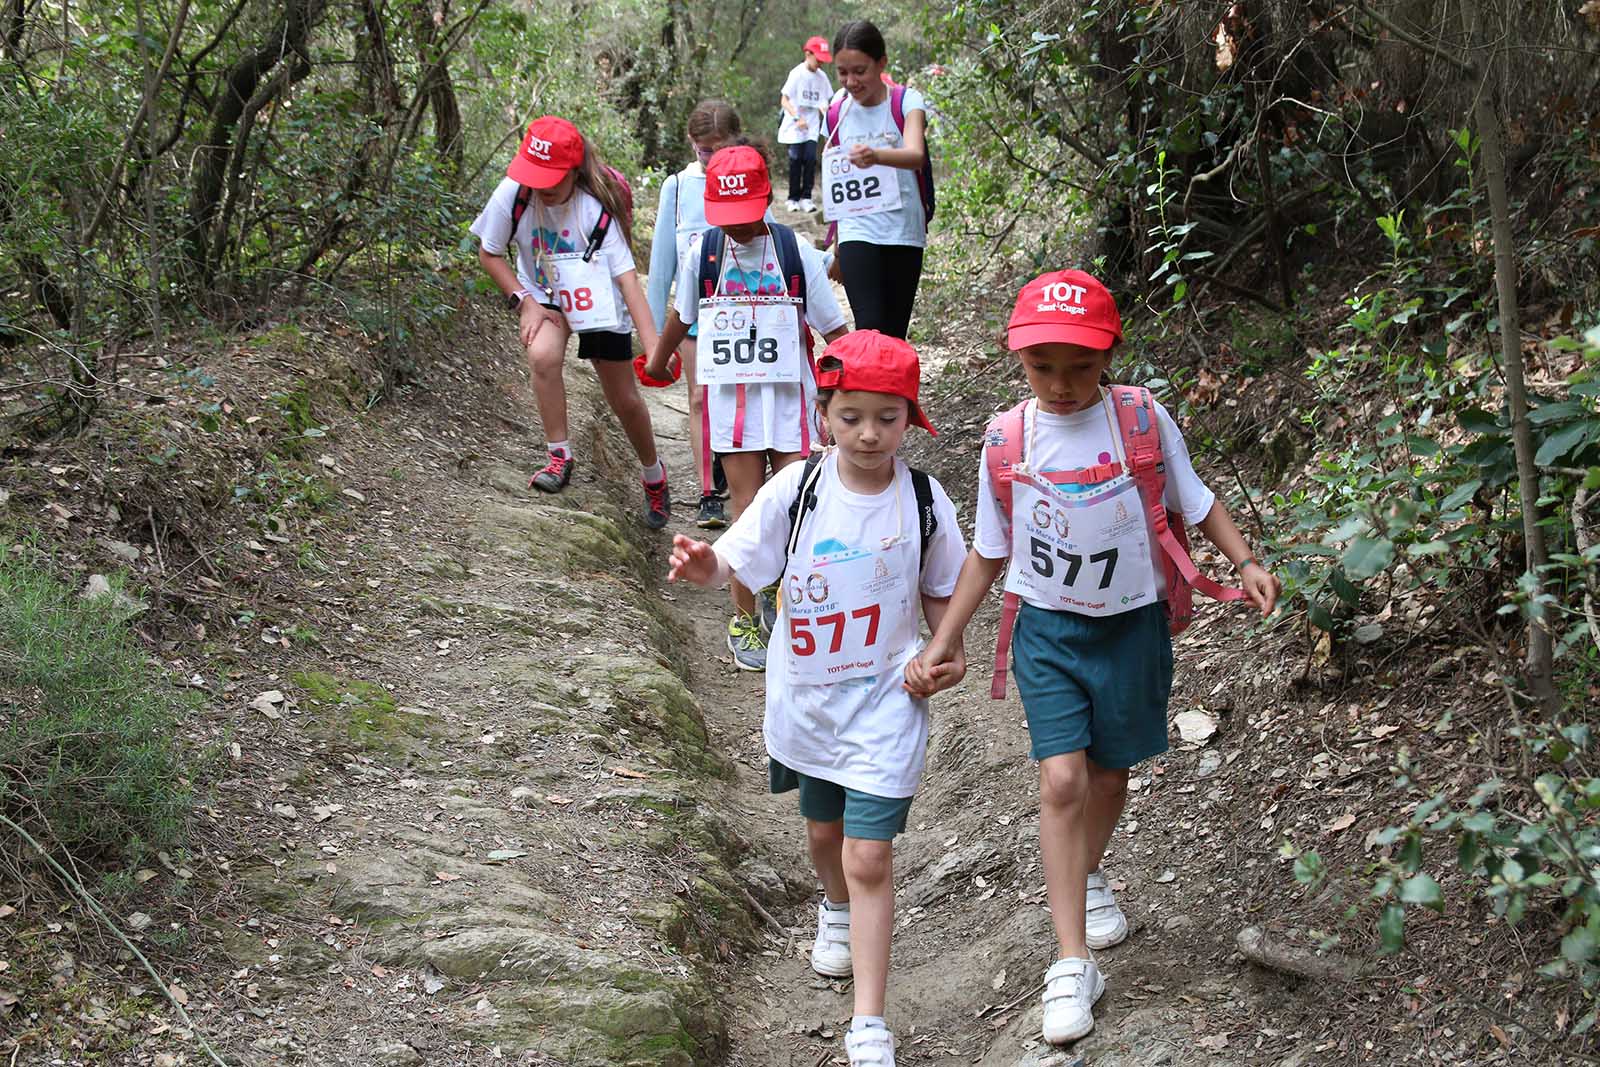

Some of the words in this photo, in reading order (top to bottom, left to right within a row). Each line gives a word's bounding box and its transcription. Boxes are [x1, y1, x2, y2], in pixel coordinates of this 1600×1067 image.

[530, 135, 553, 154] TOT
[717, 174, 746, 189] TOT
[831, 176, 882, 204] 682
[1041, 282, 1087, 304] TOT
[1037, 303, 1057, 312] Sant
[1060, 303, 1086, 315] Cugat
[713, 338, 778, 365] 508
[1030, 536, 1119, 590] 577
[789, 603, 881, 656] 577
